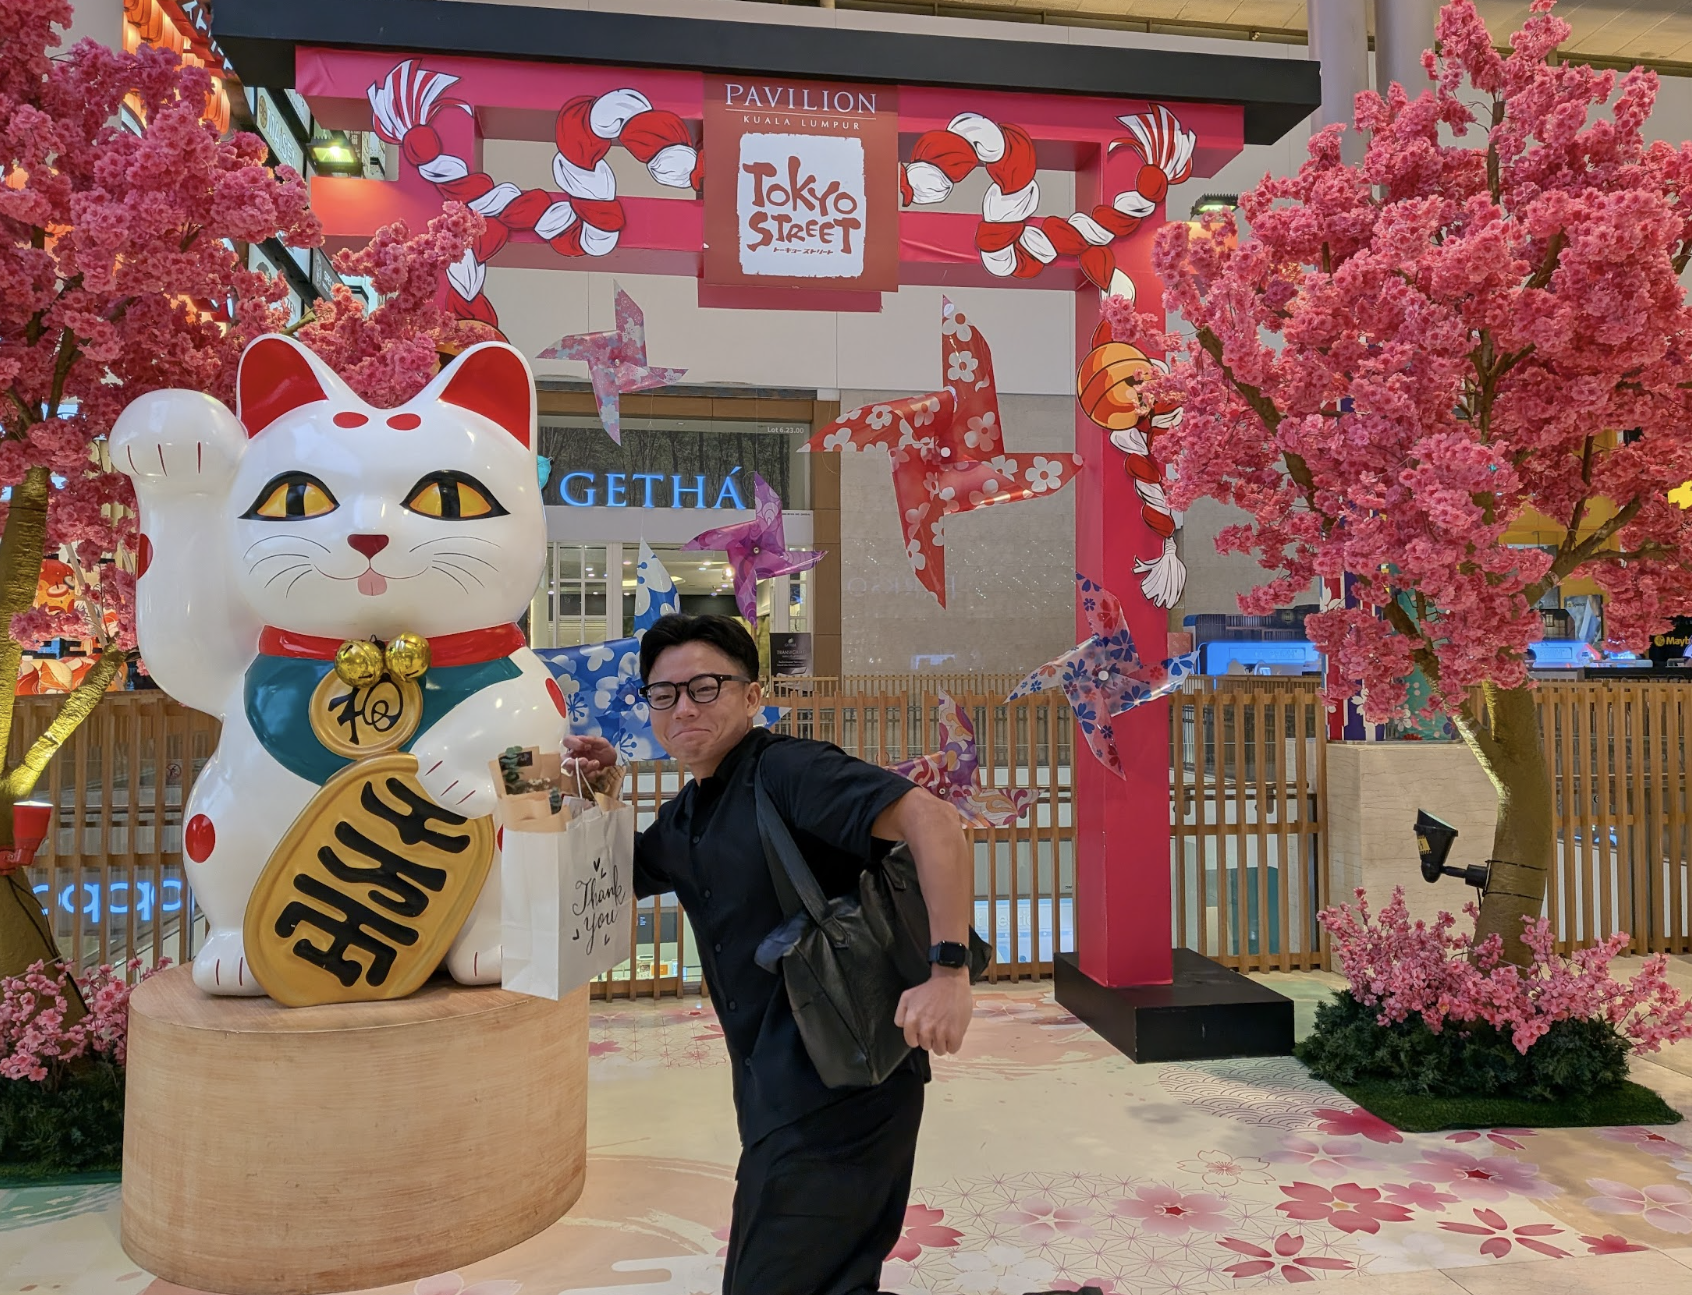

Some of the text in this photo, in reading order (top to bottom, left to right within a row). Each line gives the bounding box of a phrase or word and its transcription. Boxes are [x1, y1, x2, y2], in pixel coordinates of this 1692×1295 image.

[725, 83, 877, 114] PAVILION
[743, 115, 860, 130] KUALA LUMPUR
[746, 210, 862, 254] STREET
[559, 466, 747, 510] GETHÁ
[571, 864, 627, 916] Thank
[583, 907, 619, 956] you
